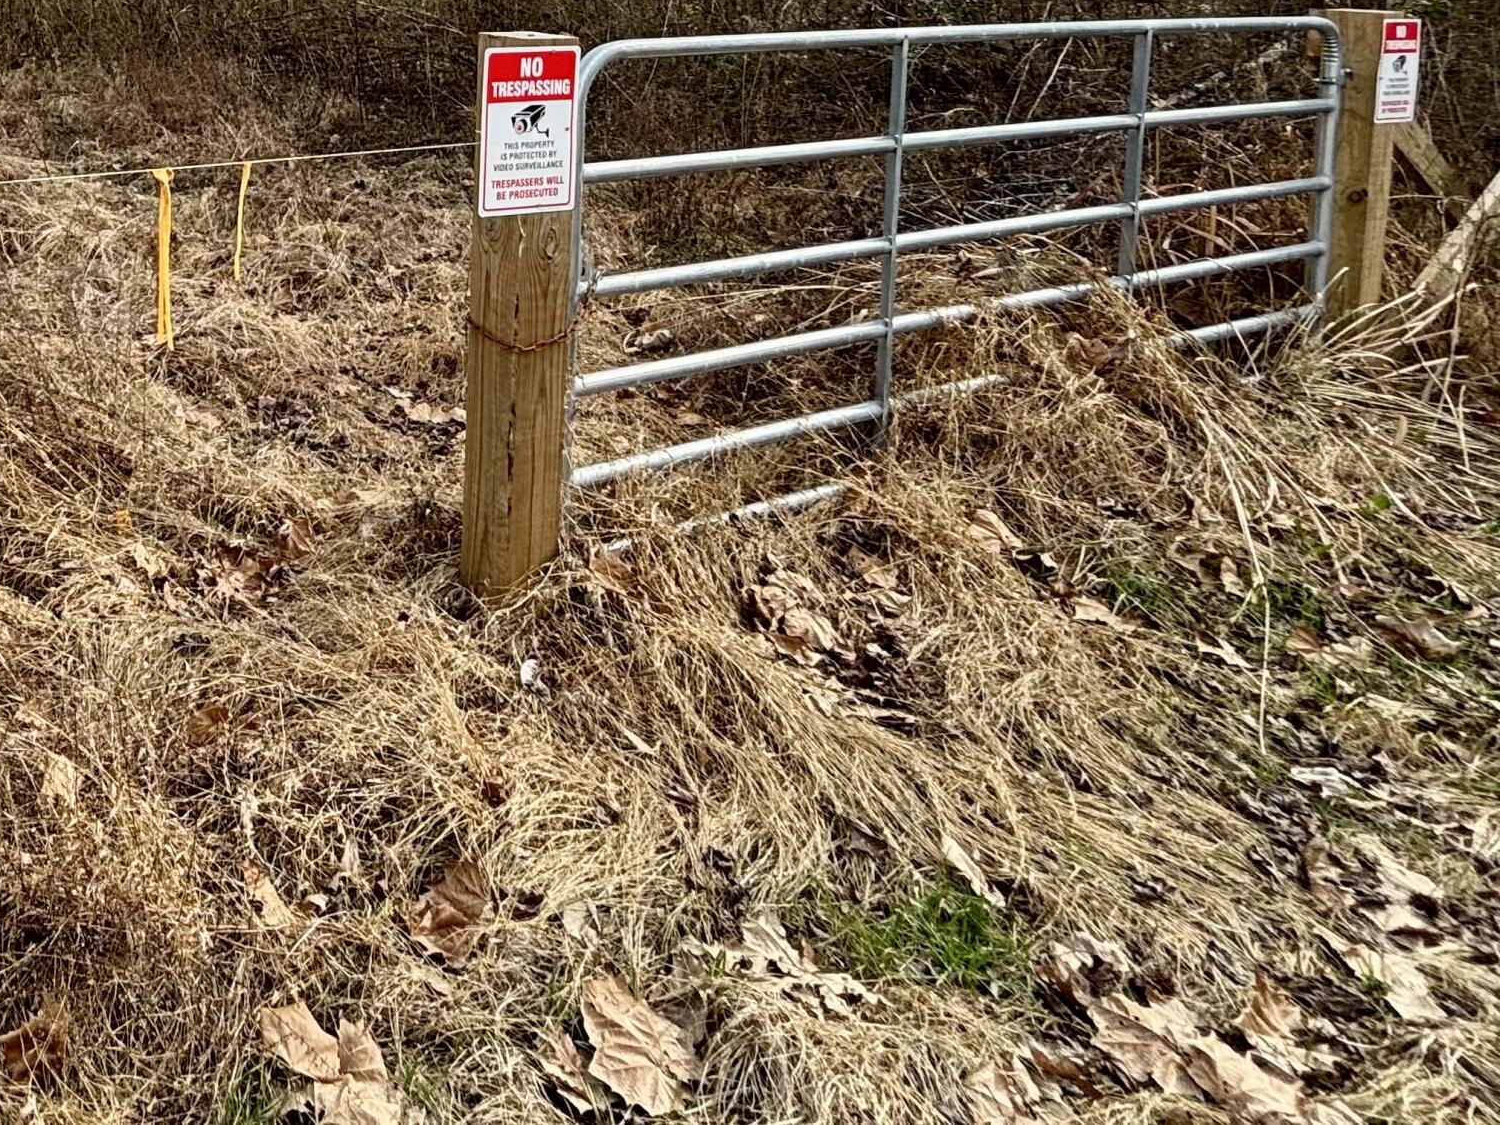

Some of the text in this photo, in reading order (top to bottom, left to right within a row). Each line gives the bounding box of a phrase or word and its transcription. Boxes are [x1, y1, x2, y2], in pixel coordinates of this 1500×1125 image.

[520, 57, 543, 78] NO
[491, 79, 571, 98] TRESPASSING
[504, 140, 555, 150] THIS PROPERTY
[500, 150, 557, 161] IS PROTECTED BY
[493, 160, 563, 172] VIDEO SURVEILLANCE
[491, 175, 565, 189] TRESPASSERS WILL
[496, 187, 559, 200] BE PROSECUTED
